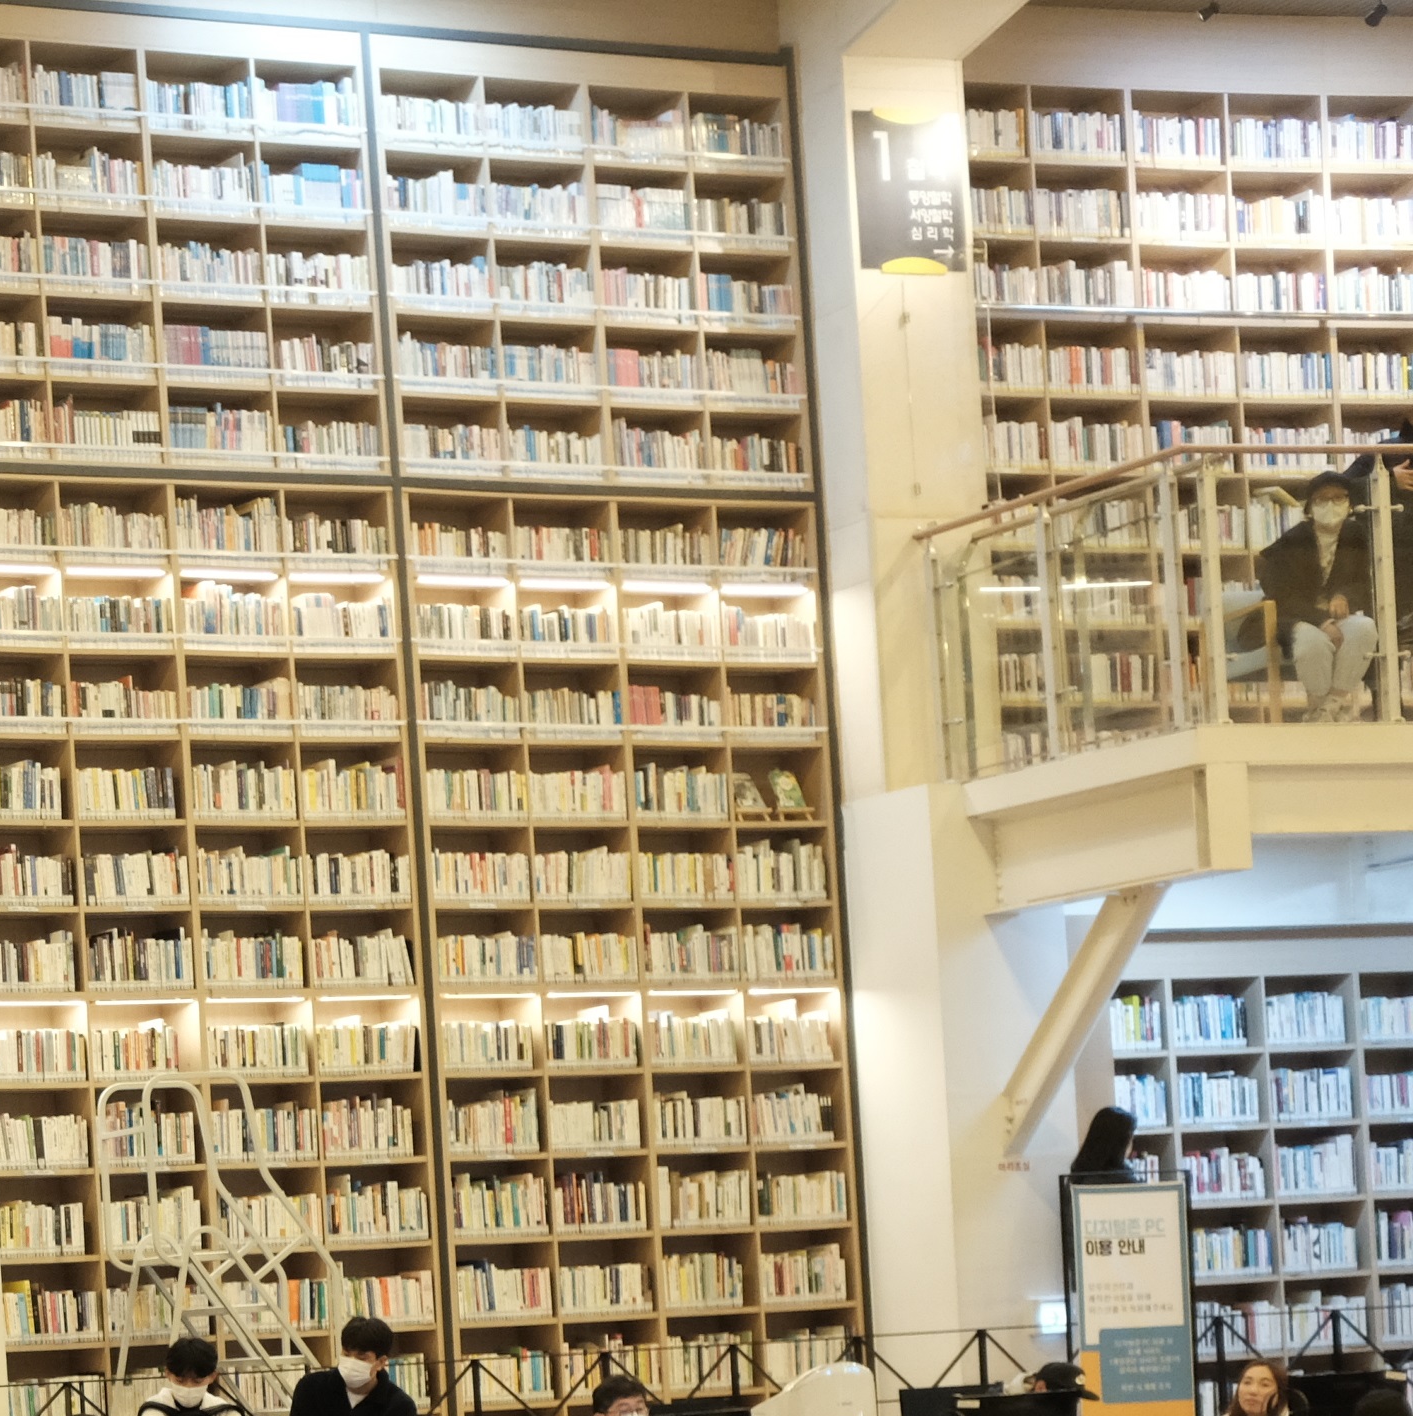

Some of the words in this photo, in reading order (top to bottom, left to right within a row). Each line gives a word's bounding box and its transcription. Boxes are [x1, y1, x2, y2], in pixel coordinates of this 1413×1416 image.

[873, 131, 891, 181] 1
[1145, 1218, 1165, 1233] PC
[1085, 1239, 1113, 1256] 이용
[1118, 1238, 1146, 1255] 안내
